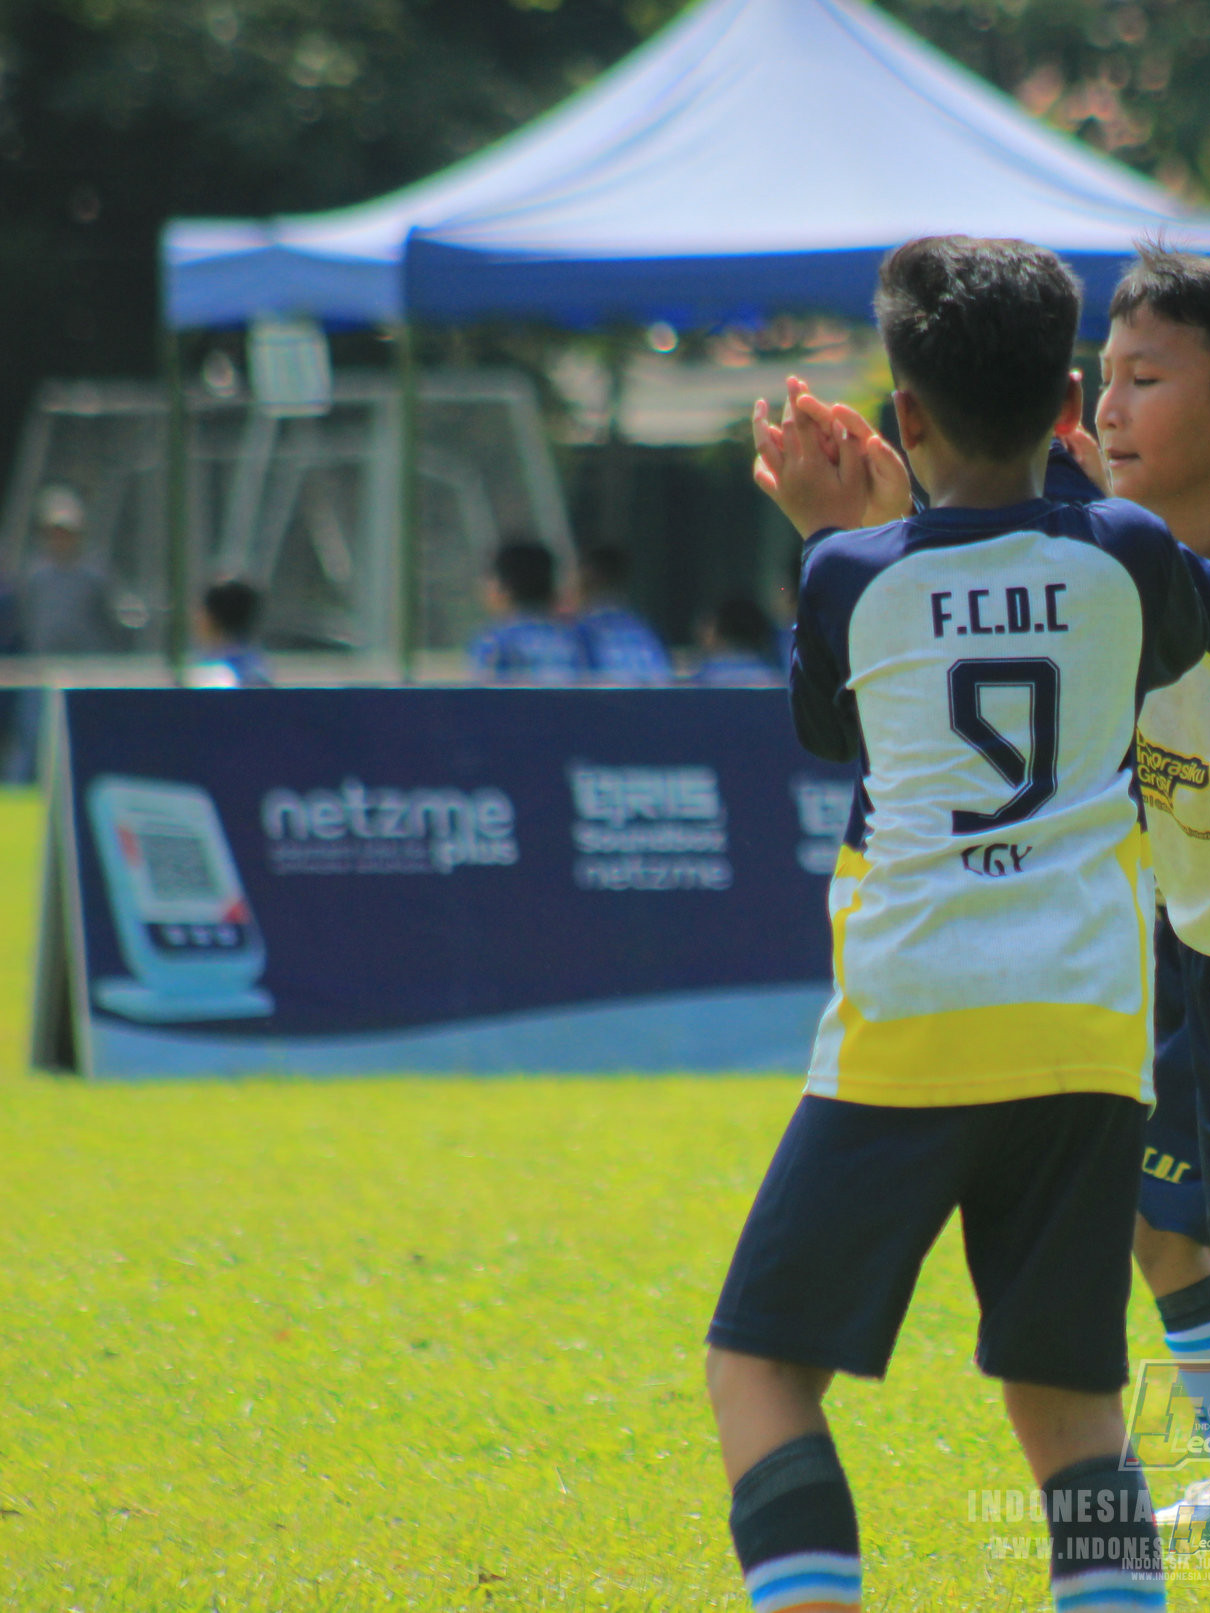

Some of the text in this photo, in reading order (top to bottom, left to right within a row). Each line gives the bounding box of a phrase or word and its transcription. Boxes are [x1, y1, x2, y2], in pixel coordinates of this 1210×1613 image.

[931, 583, 1069, 638] F.C.D.C
[947, 657, 1060, 835] 9
[262, 778, 515, 839] netzme
[432, 838, 518, 873] plus
[576, 852, 733, 890] netzme
[1141, 1147, 1191, 1184] C.D.C
